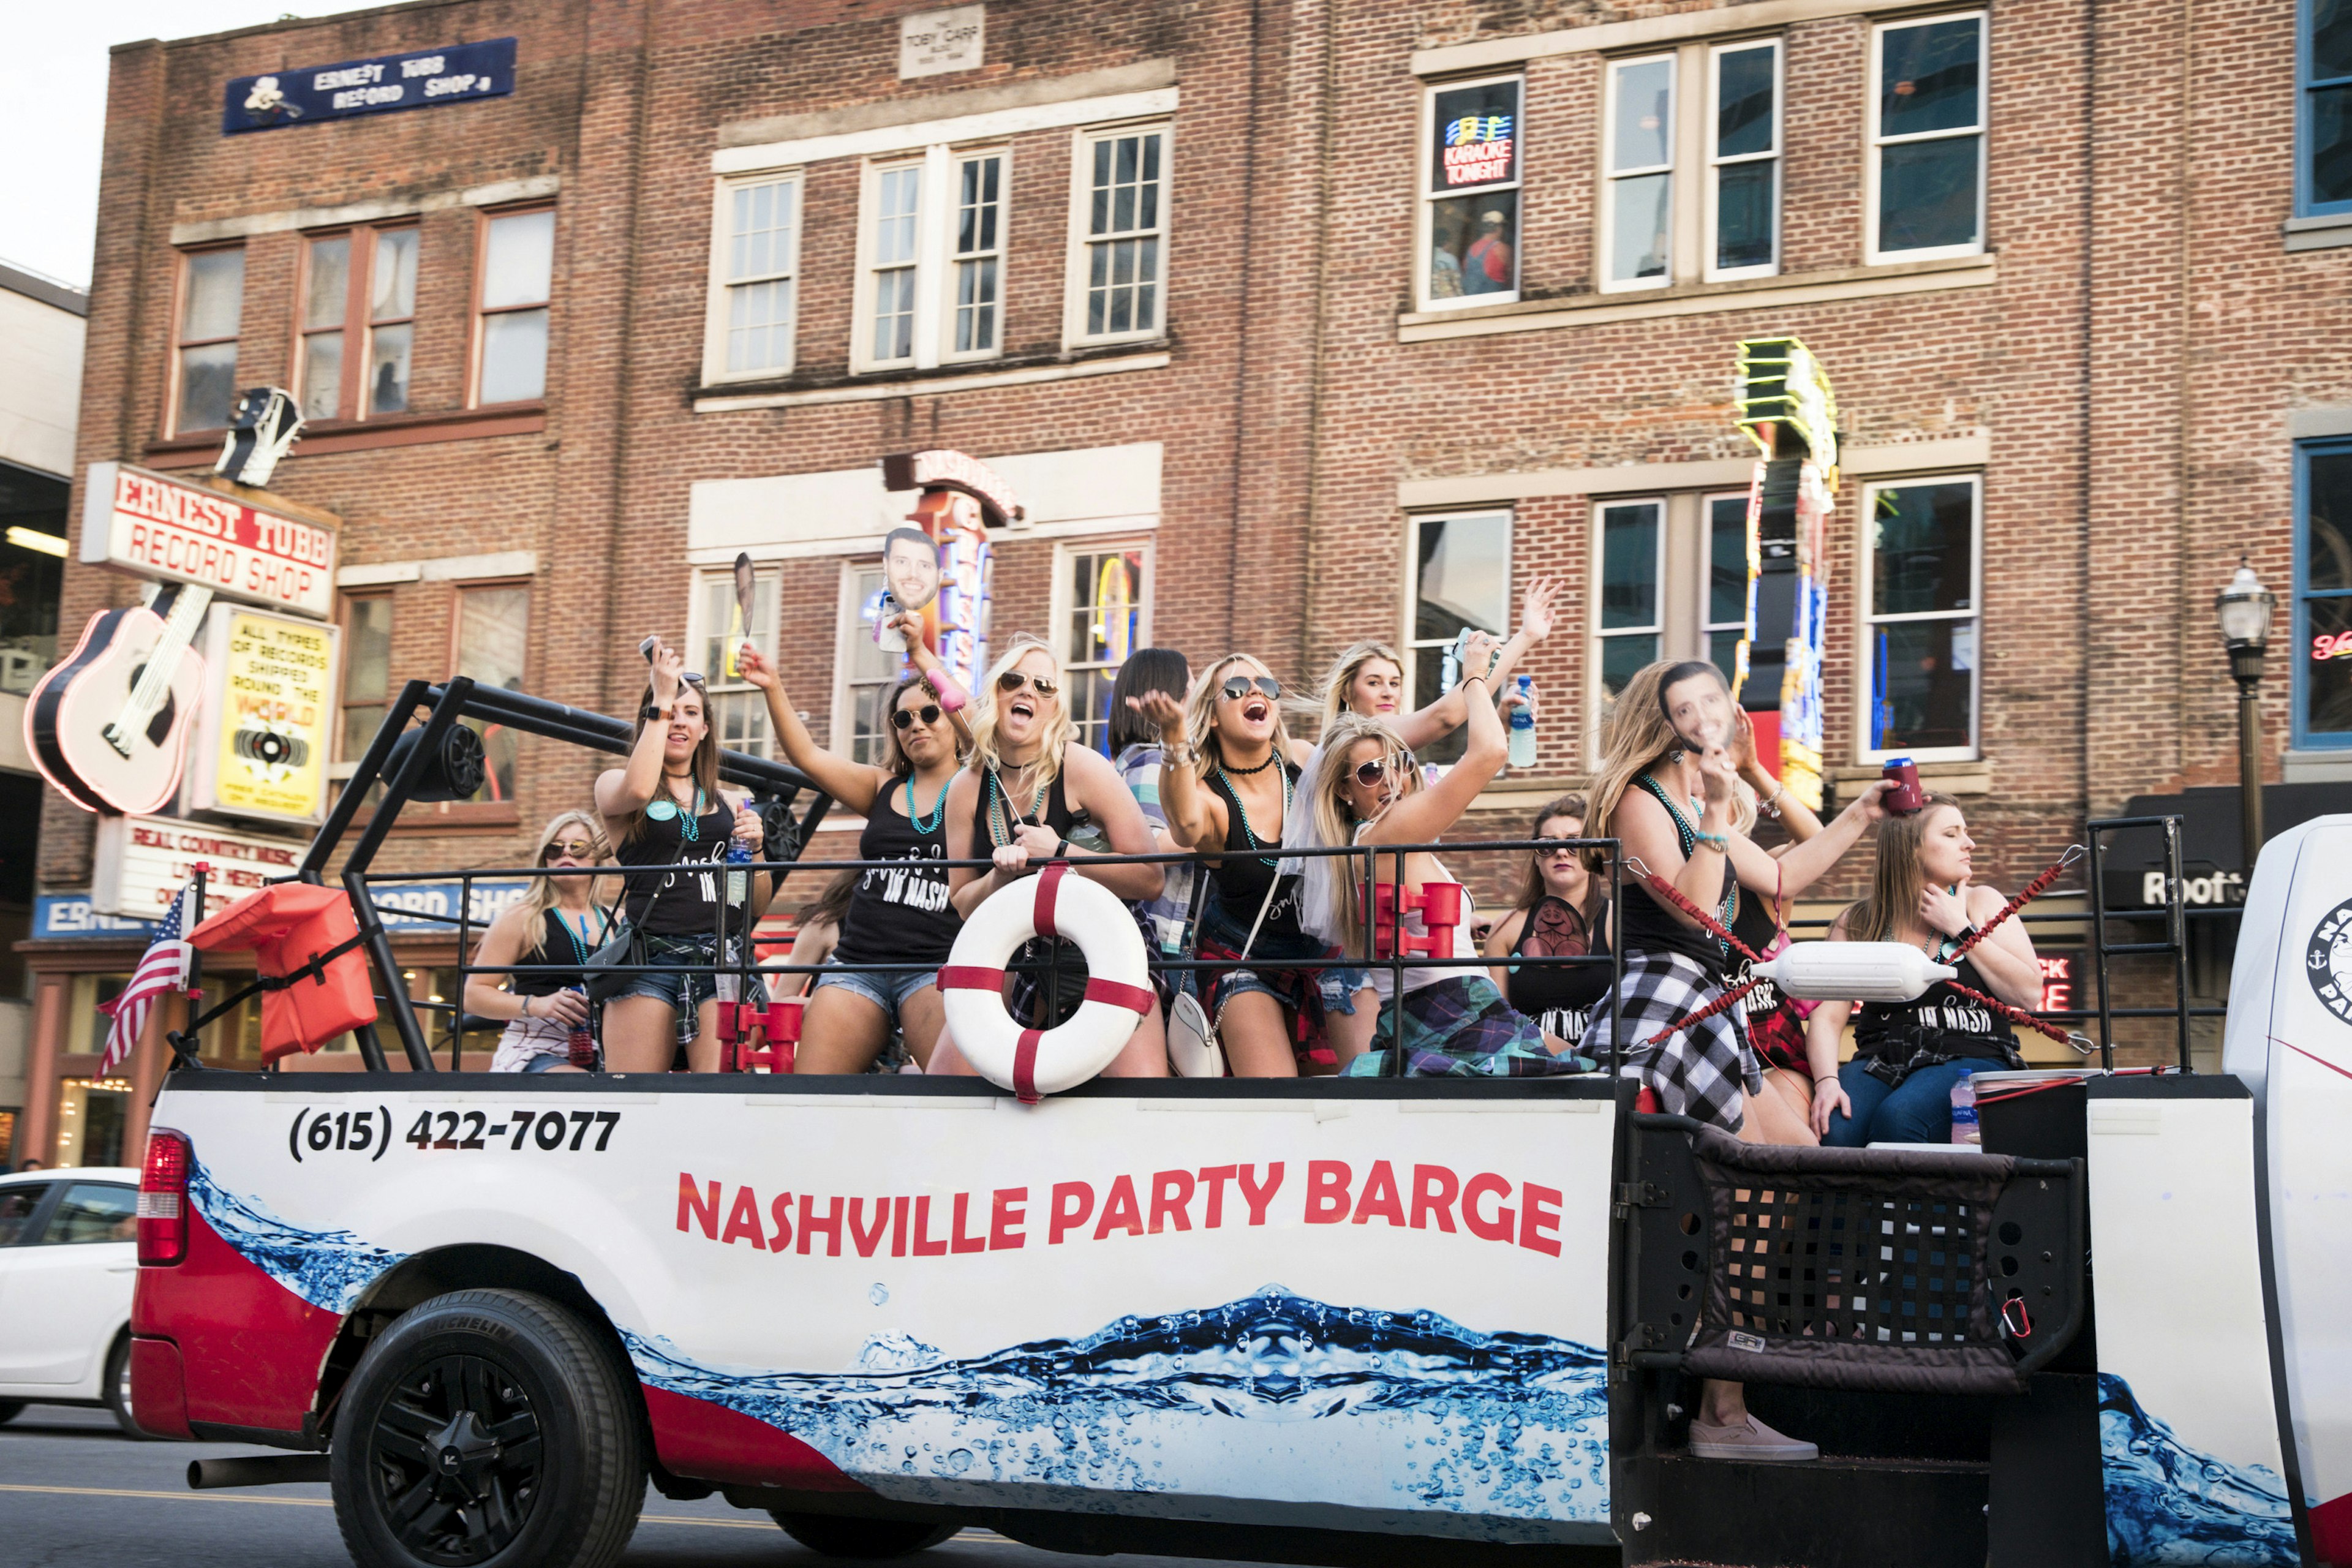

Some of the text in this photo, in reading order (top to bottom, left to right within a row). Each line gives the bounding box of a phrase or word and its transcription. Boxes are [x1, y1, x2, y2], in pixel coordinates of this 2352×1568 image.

[313, 55, 445, 91] ERNEST TUBB
[333, 84, 404, 110] RECORD
[424, 74, 476, 97] SHOP
[1444, 139, 1513, 167] KARAOKE
[1446, 158, 1509, 185] TONIGHT
[116, 470, 329, 567] ERNEST TUBB
[129, 524, 311, 603] RECORD SHOP
[241, 624, 322, 652] ALL TYPES
[230, 639, 328, 670] OF RECORDS
[249, 660, 308, 683] SHIPPED
[233, 675, 318, 703] ROUND THE
[235, 694, 315, 727] WORLD
[133, 827, 173, 850] REAL
[180, 835, 249, 861] COUNTRY
[172, 862, 218, 883] LIS
[883, 872, 951, 913] IN NASH
[1540, 1011, 1557, 1036] IN
[1559, 1010, 1589, 1041] NA
[1918, 1006, 1938, 1028] IN
[1943, 1006, 1991, 1033] NASH
[289, 1104, 621, 1164] (615) 422-7077
[676, 1159, 1563, 1259] NASHVILLE PARTY BARGE
[424, 1317, 516, 1340] MICHELIN
